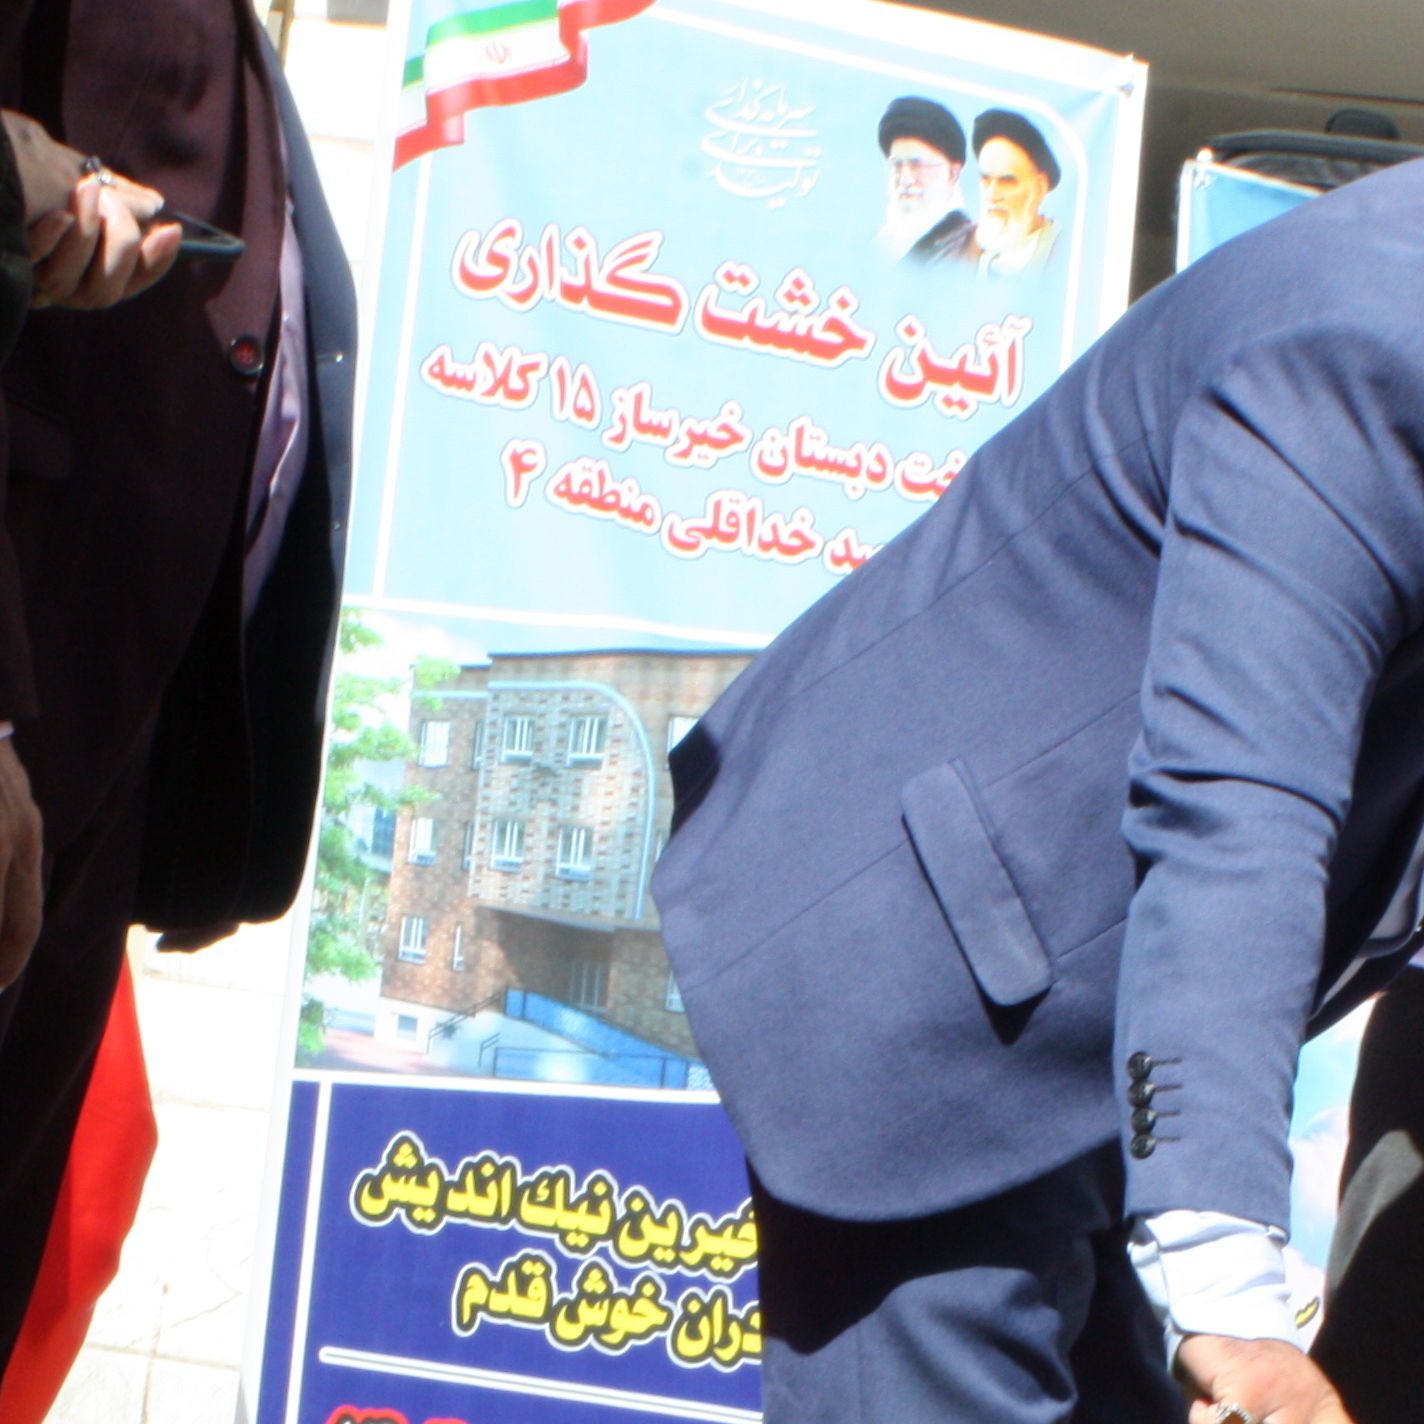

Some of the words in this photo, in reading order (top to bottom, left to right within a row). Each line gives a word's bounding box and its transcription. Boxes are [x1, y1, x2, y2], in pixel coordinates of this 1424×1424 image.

[459, 225, 683, 327] گذاری
[700, 267, 869, 361] خشت
[426, 349, 542, 402] کلاسه
[555, 364, 596, 423] ۱۵
[884, 320, 1025, 413] آئین
[507, 447, 540, 501] ۴
[757, 424, 888, 493] دبستان
[552, 465, 655, 527] منطقه
[360, 1142, 513, 1224] اندیش
[461, 1259, 548, 1325] قدم
[554, 1267, 668, 1344] خوش
